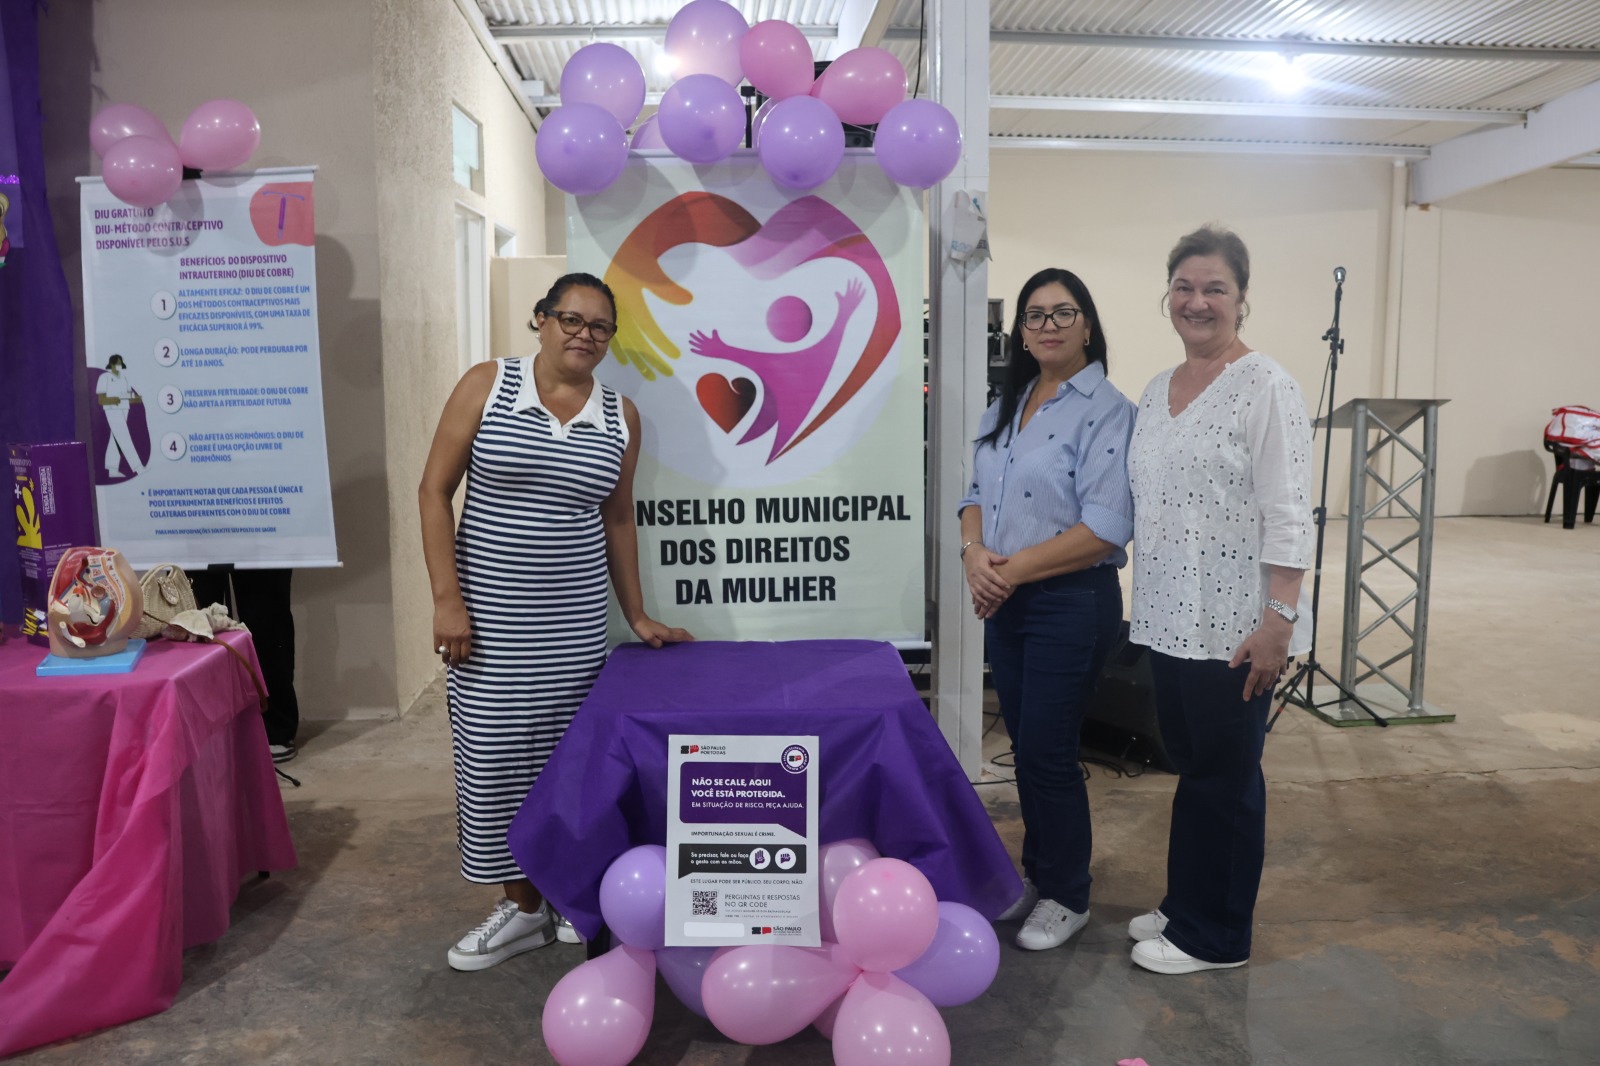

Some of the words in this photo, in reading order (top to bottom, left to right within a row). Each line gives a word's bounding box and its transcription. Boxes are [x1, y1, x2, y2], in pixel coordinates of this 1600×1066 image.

[95, 210, 109, 219] DIU
[111, 208, 153, 218] GRATUITO
[153, 220, 223, 232] CONTRACEPTIVO
[96, 237, 145, 249] DISPONÍVEL
[147, 238, 168, 247] PELO
[180, 255, 226, 266] BENEFÍCIOS
[240, 255, 287, 264] DISPOSITIVO
[180, 270, 237, 280] INTRAUTERINO
[238, 270, 254, 280] (DIU
[255, 269, 266, 277] DE
[267, 268, 294, 277] COBRE)
[179, 289, 217, 297] ALTAMENTE
[219, 288, 243, 296] EFICAZ:
[273, 286, 294, 294] COBRE
[161, 299, 166, 311] 1
[193, 299, 226, 308] MÉTODOS
[228, 298, 283, 307] CONTRACEPTIVOS
[179, 312, 209, 320] EFICAZES
[210, 310, 253, 320] DISPONÍVEIS,
[254, 310, 268, 318] COM
[286, 309, 301, 317] TAXA
[179, 323, 208, 332] EFICÁCIA
[209, 323, 242, 331] SUPERIOR
[163, 346, 170, 358] 2
[180, 348, 204, 356] LONGA
[205, 345, 239, 356] DURAÇÃO:
[241, 346, 259, 354] PODE
[259, 345, 294, 354] PERDURAR
[295, 344, 308, 352] POR
[182, 358, 193, 367] ATÉ
[195, 359, 203, 367] 10
[204, 358, 224, 367] ANOS.
[184, 389, 216, 397] PRESERVA
[218, 388, 259, 397] FERTILIDADE:
[267, 387, 277, 395] DIU
[279, 387, 287, 395] DE
[288, 386, 308, 394] COBRE
[167, 394, 174, 405] 3
[184, 400, 198, 408] NÃO
[199, 400, 220, 408] AFETA
[225, 399, 265, 407] FERTILIDADE
[189, 433, 203, 441] NÃO
[204, 433, 224, 441] AFETA
[225, 432, 234, 440] OS
[235, 431, 275, 440] HORMÔNIOS:
[283, 431, 294, 439] DIU
[170, 441, 177, 452] 4
[218, 443, 232, 451] UMA
[233, 442, 255, 452] OPÇÃO
[274, 442, 282, 450] DE
[191, 454, 231, 463] HORMÔNIOS
[153, 488, 193, 496] IMPORTANTE
[217, 488, 230, 496] QUE
[249, 486, 272, 494] PESSOA
[279, 485, 298, 493] ÚNICA
[150, 500, 166, 508] PODE
[167, 498, 215, 507] EXPERIMENTAR
[216, 497, 252, 506] BENEFÍCIOS
[150, 510, 187, 518] COLATERAIS
[188, 509, 226, 517] DIFERENTES
[226, 508, 240, 516] COM
[269, 507, 290, 515] COBRE
[636, 498, 745, 526] NSELHO
[756, 495, 911, 524] MUNICIPAL
[179, 527, 211, 535] INFORMAÇÕES
[660, 539, 716, 566] DOS
[726, 536, 850, 564] DIREITOS
[676, 579, 713, 605] DA
[722, 576, 836, 603] MULHER
[692, 777, 712, 786] NÃO
[725, 779, 747, 787] CALE,
[749, 779, 771, 787] AQUI
[691, 788, 714, 797] VOCÊ
[716, 788, 734, 798] ESTÁ
[702, 801, 733, 809] SITUAÇÃO
